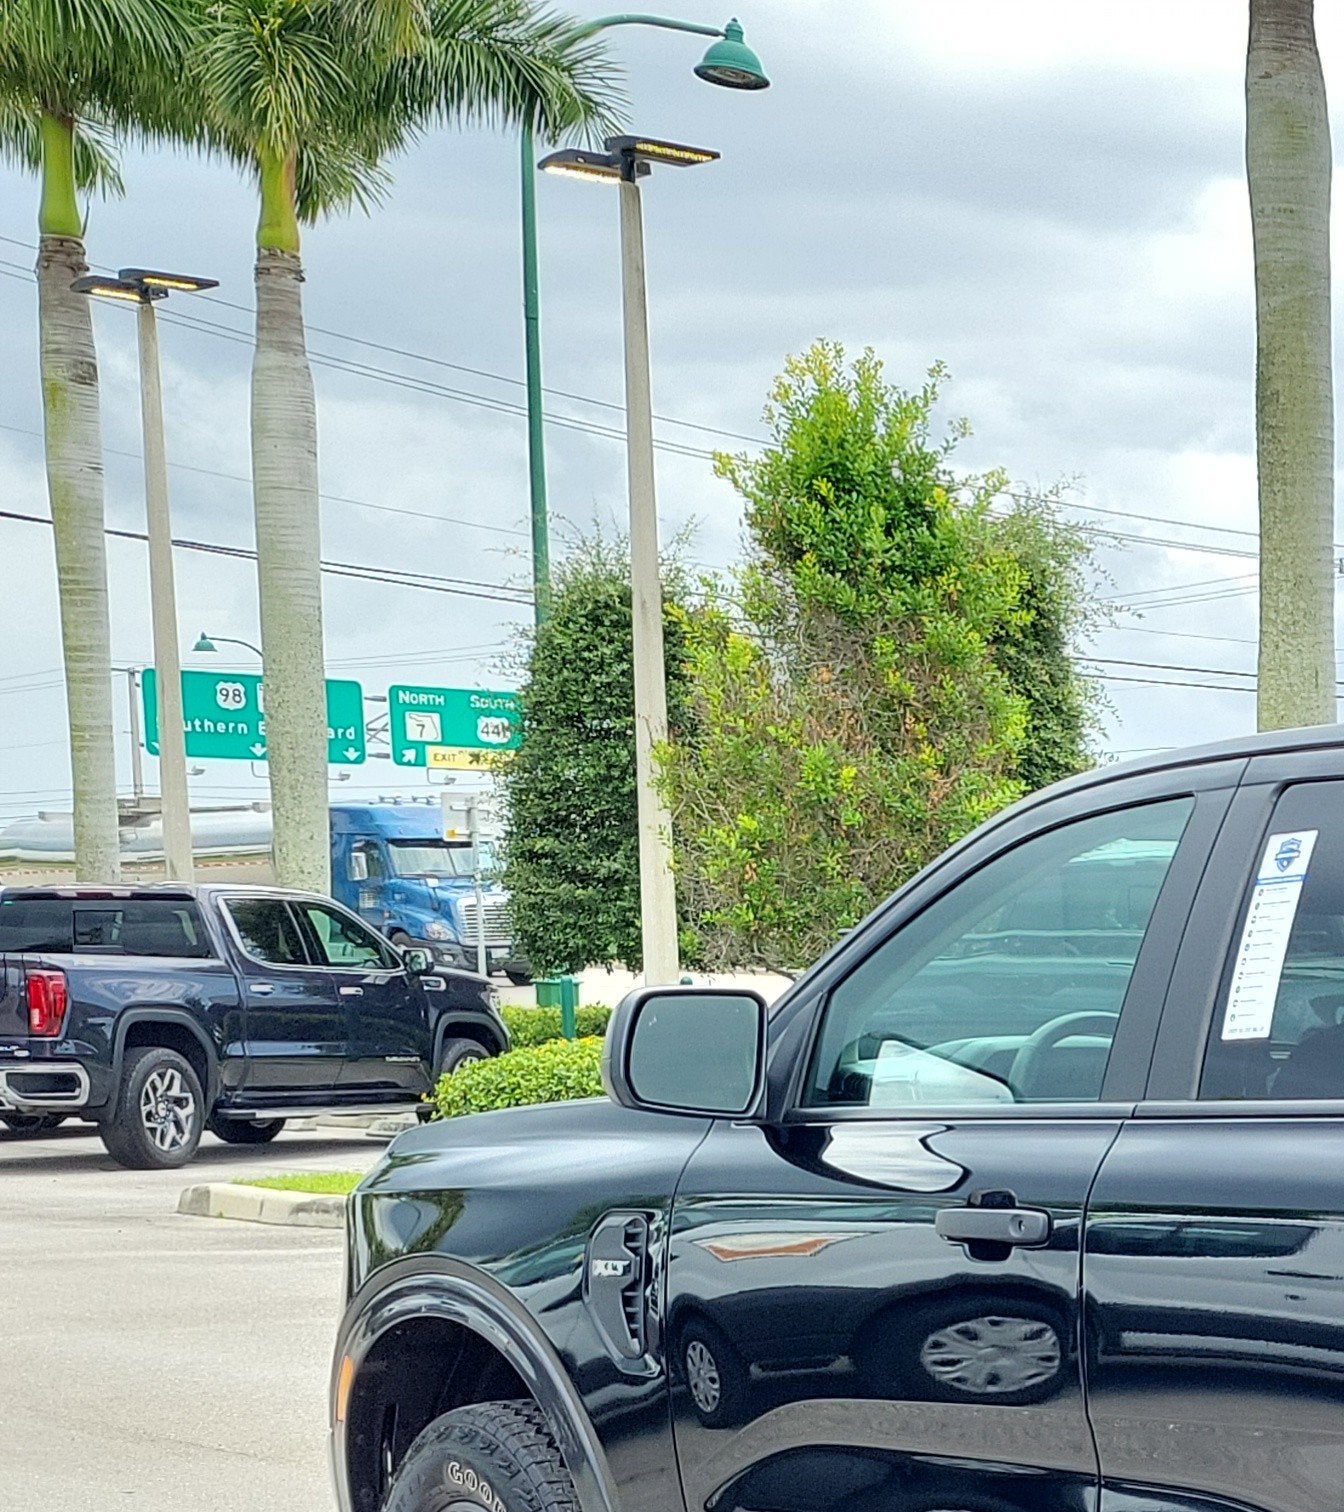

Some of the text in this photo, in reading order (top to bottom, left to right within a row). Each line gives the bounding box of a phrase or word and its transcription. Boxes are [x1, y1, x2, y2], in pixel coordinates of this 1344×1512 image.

[218, 688, 243, 704] 98
[398, 690, 515, 710] NORTH SOUTH
[415, 723, 426, 738] 7
[433, 753, 457, 762] EXIT
